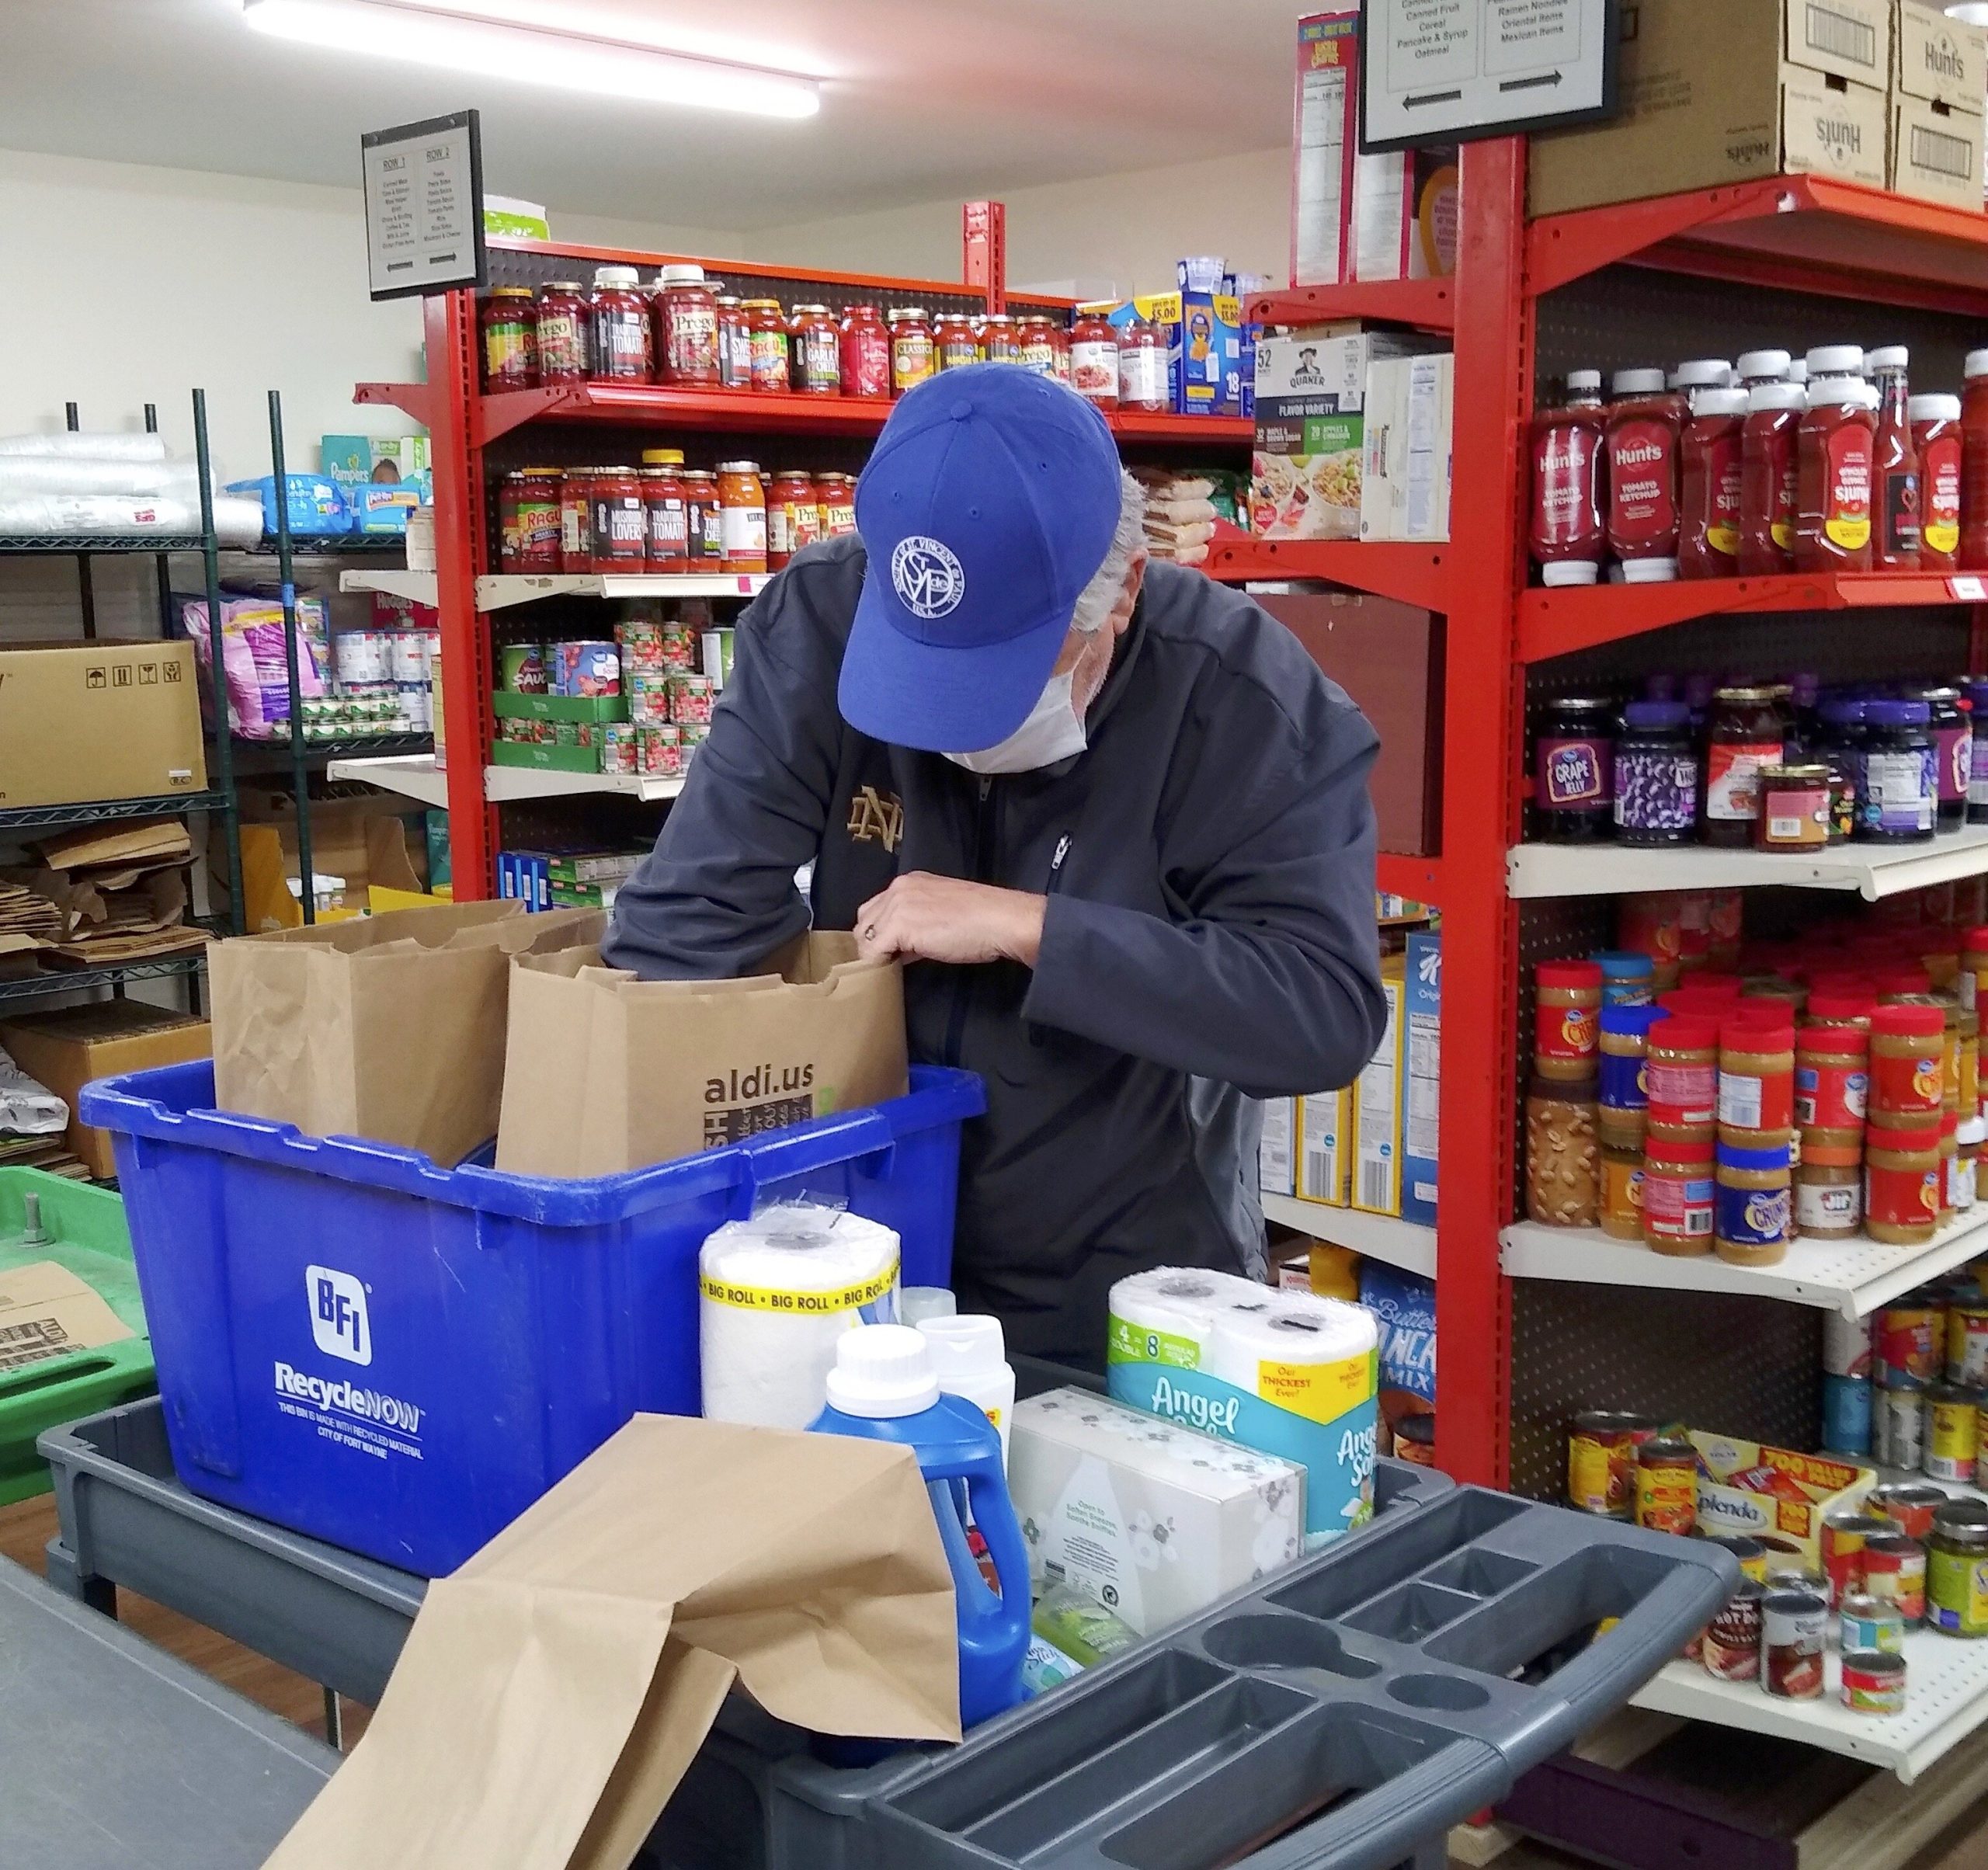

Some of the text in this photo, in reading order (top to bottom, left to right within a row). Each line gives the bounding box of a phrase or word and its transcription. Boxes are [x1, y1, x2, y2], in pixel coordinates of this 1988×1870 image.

[1406, 2, 1460, 21] Canned Fruit
[1501, 11, 1564, 30] Oriental Items
[1419, 19, 1446, 32] Cereal
[1539, 25, 1564, 36] Items
[1397, 29, 1468, 48] Pancake & Syrup
[1414, 45, 1449, 59] Oatmeal
[384, 158, 398, 170] ROW
[426, 148, 443, 162] ROW
[675, 315, 714, 330] Prego
[1257, 349, 1272, 368] 52
[1226, 372, 1239, 394] 18
[1290, 374, 1326, 388] QUAKER
[1279, 403, 1335, 417] FLAVOR VARIETY
[330, 461, 370, 485] Pampers
[1618, 488, 1661, 503] KETCHUP
[1621, 480, 1658, 493] TOMATO
[527, 509, 562, 530] RAGU
[611, 522, 642, 541] LOVERS
[1555, 760, 1590, 784] GRAPE
[1565, 780, 1586, 794] JELLY
[704, 1063, 814, 1104] aldi.us
[708, 1282, 755, 1305] BIG ROLL
[771, 1295, 829, 1310] BIG ROLL
[844, 1289, 863, 1305] BIG
[318, 1277, 360, 1353] BFI
[1147, 1335, 1159, 1358] 8
[1278, 1367, 1295, 1376] Our
[1386, 1368, 1430, 1391] MIX
[1263, 1375, 1311, 1389] THICKEST
[1152, 1376, 1239, 1434] Angel
[278, 1401, 425, 1461] THIS BIN IS MADE WITH RECYCLED MATERIAL
[317, 1426, 388, 1460] CITY OF FORT WAYNE
[1078, 1500, 1105, 1516] Open to
[1698, 1493, 1758, 1522] plenda
